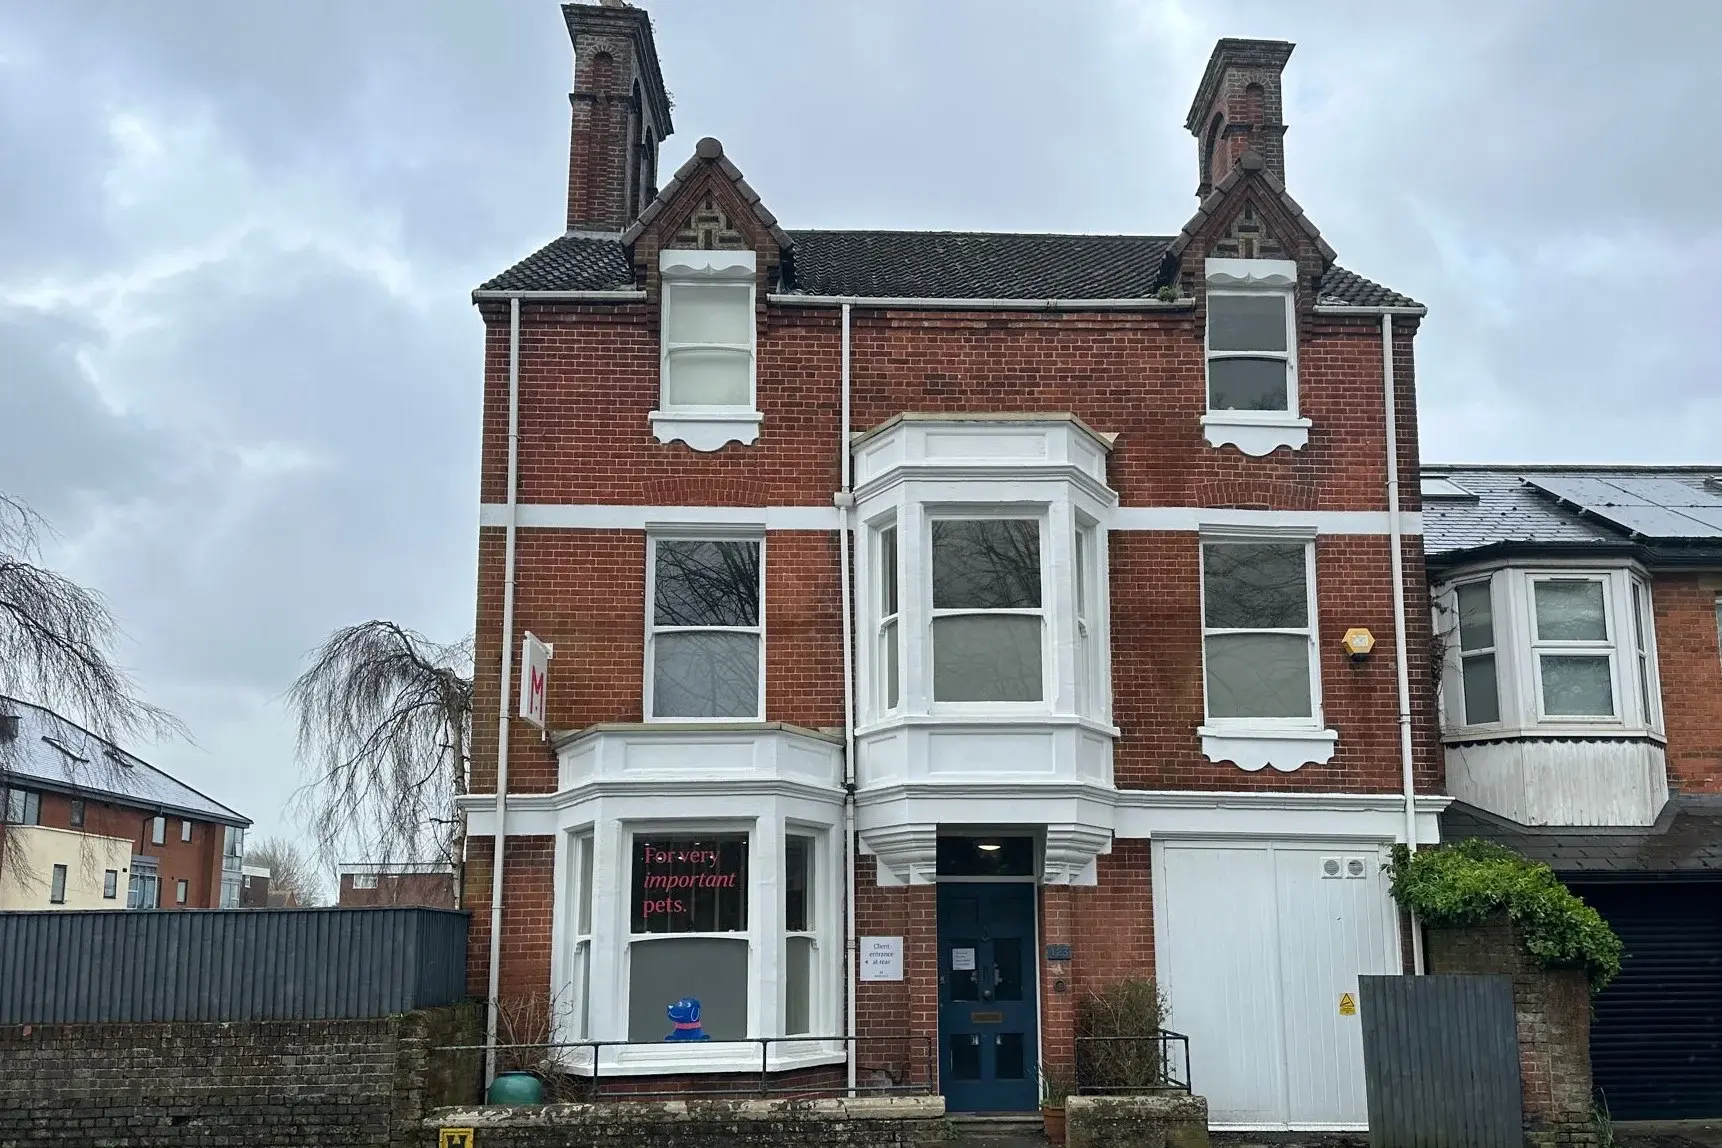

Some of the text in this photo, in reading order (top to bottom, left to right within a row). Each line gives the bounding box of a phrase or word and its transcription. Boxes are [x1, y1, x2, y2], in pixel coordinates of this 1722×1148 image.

[644, 847, 720, 868] For very
[644, 872, 736, 892] important
[642, 896, 687, 918] pets.
